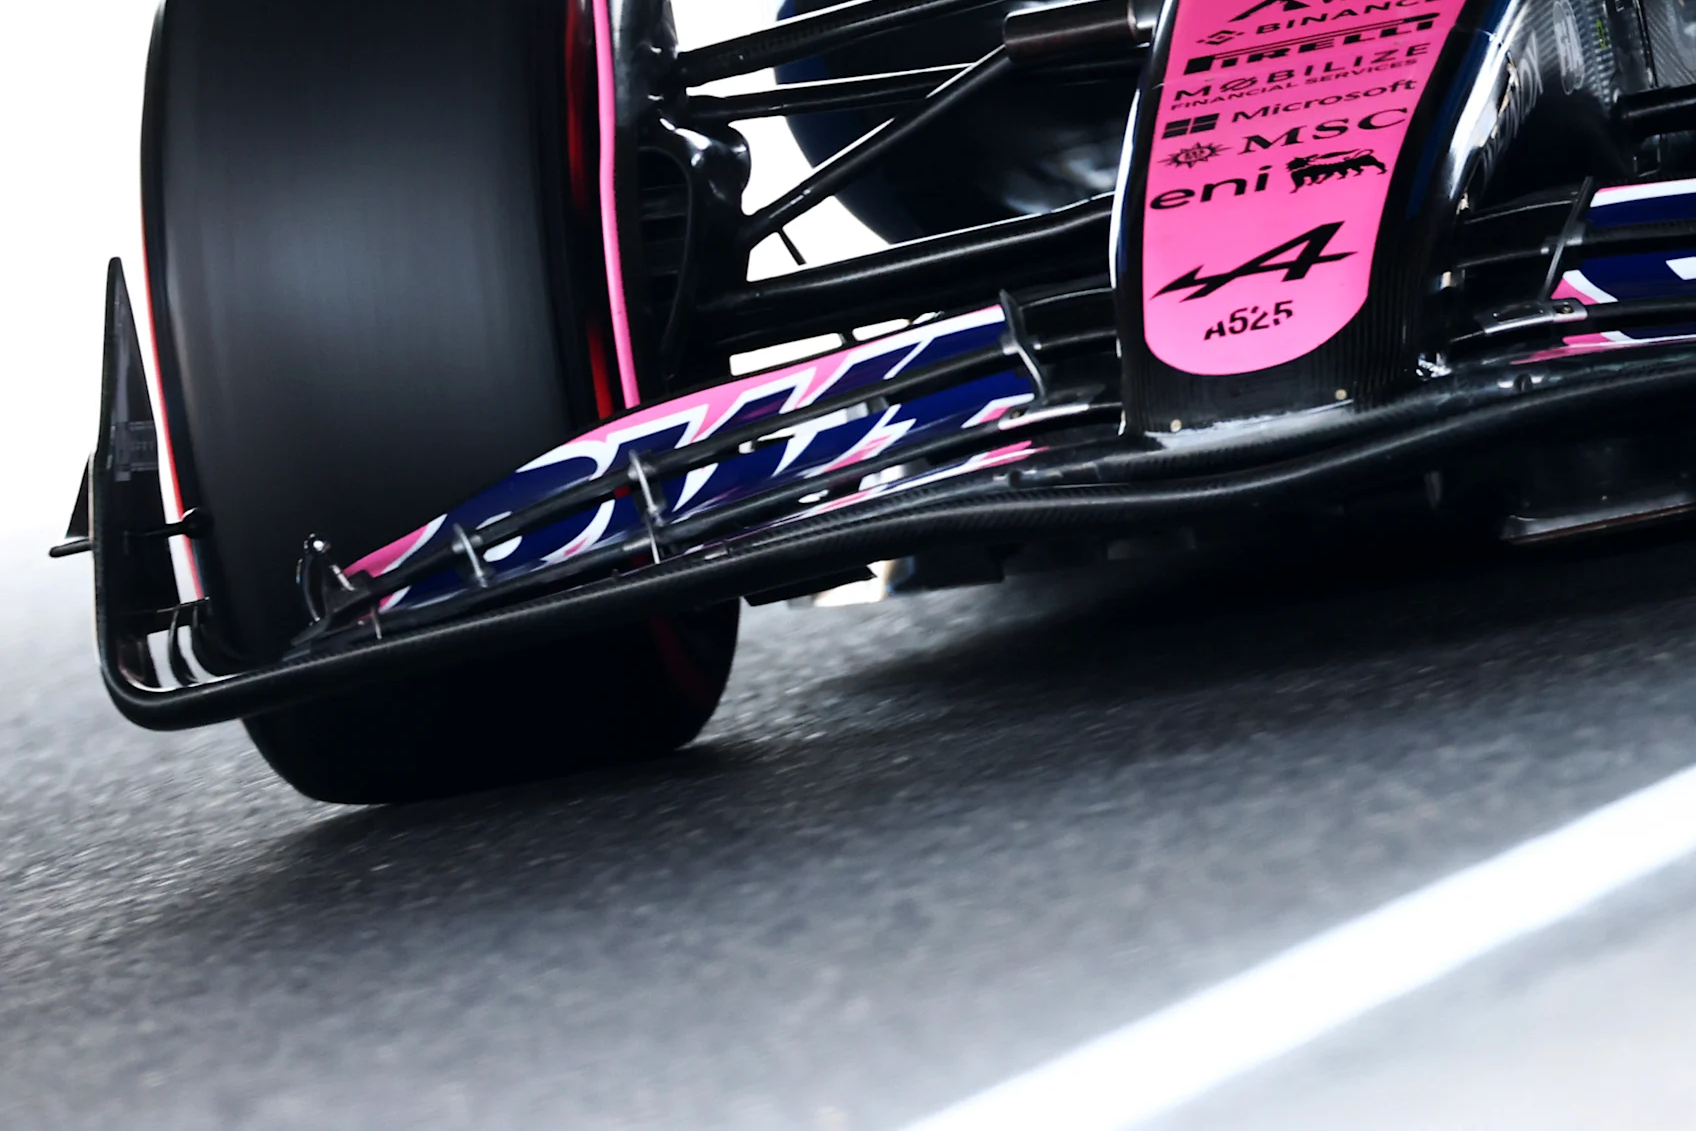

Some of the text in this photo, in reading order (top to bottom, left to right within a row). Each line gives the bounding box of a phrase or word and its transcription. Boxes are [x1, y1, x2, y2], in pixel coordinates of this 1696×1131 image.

[1183, 12, 1440, 75] PIRELLI
[1171, 59, 1418, 110] FINANCIAL SERVICES
[1232, 79, 1418, 123] Microsoft
[1237, 108, 1408, 155] MSC
[1150, 165, 1273, 210] eni
[1203, 300, 1294, 341] A525
